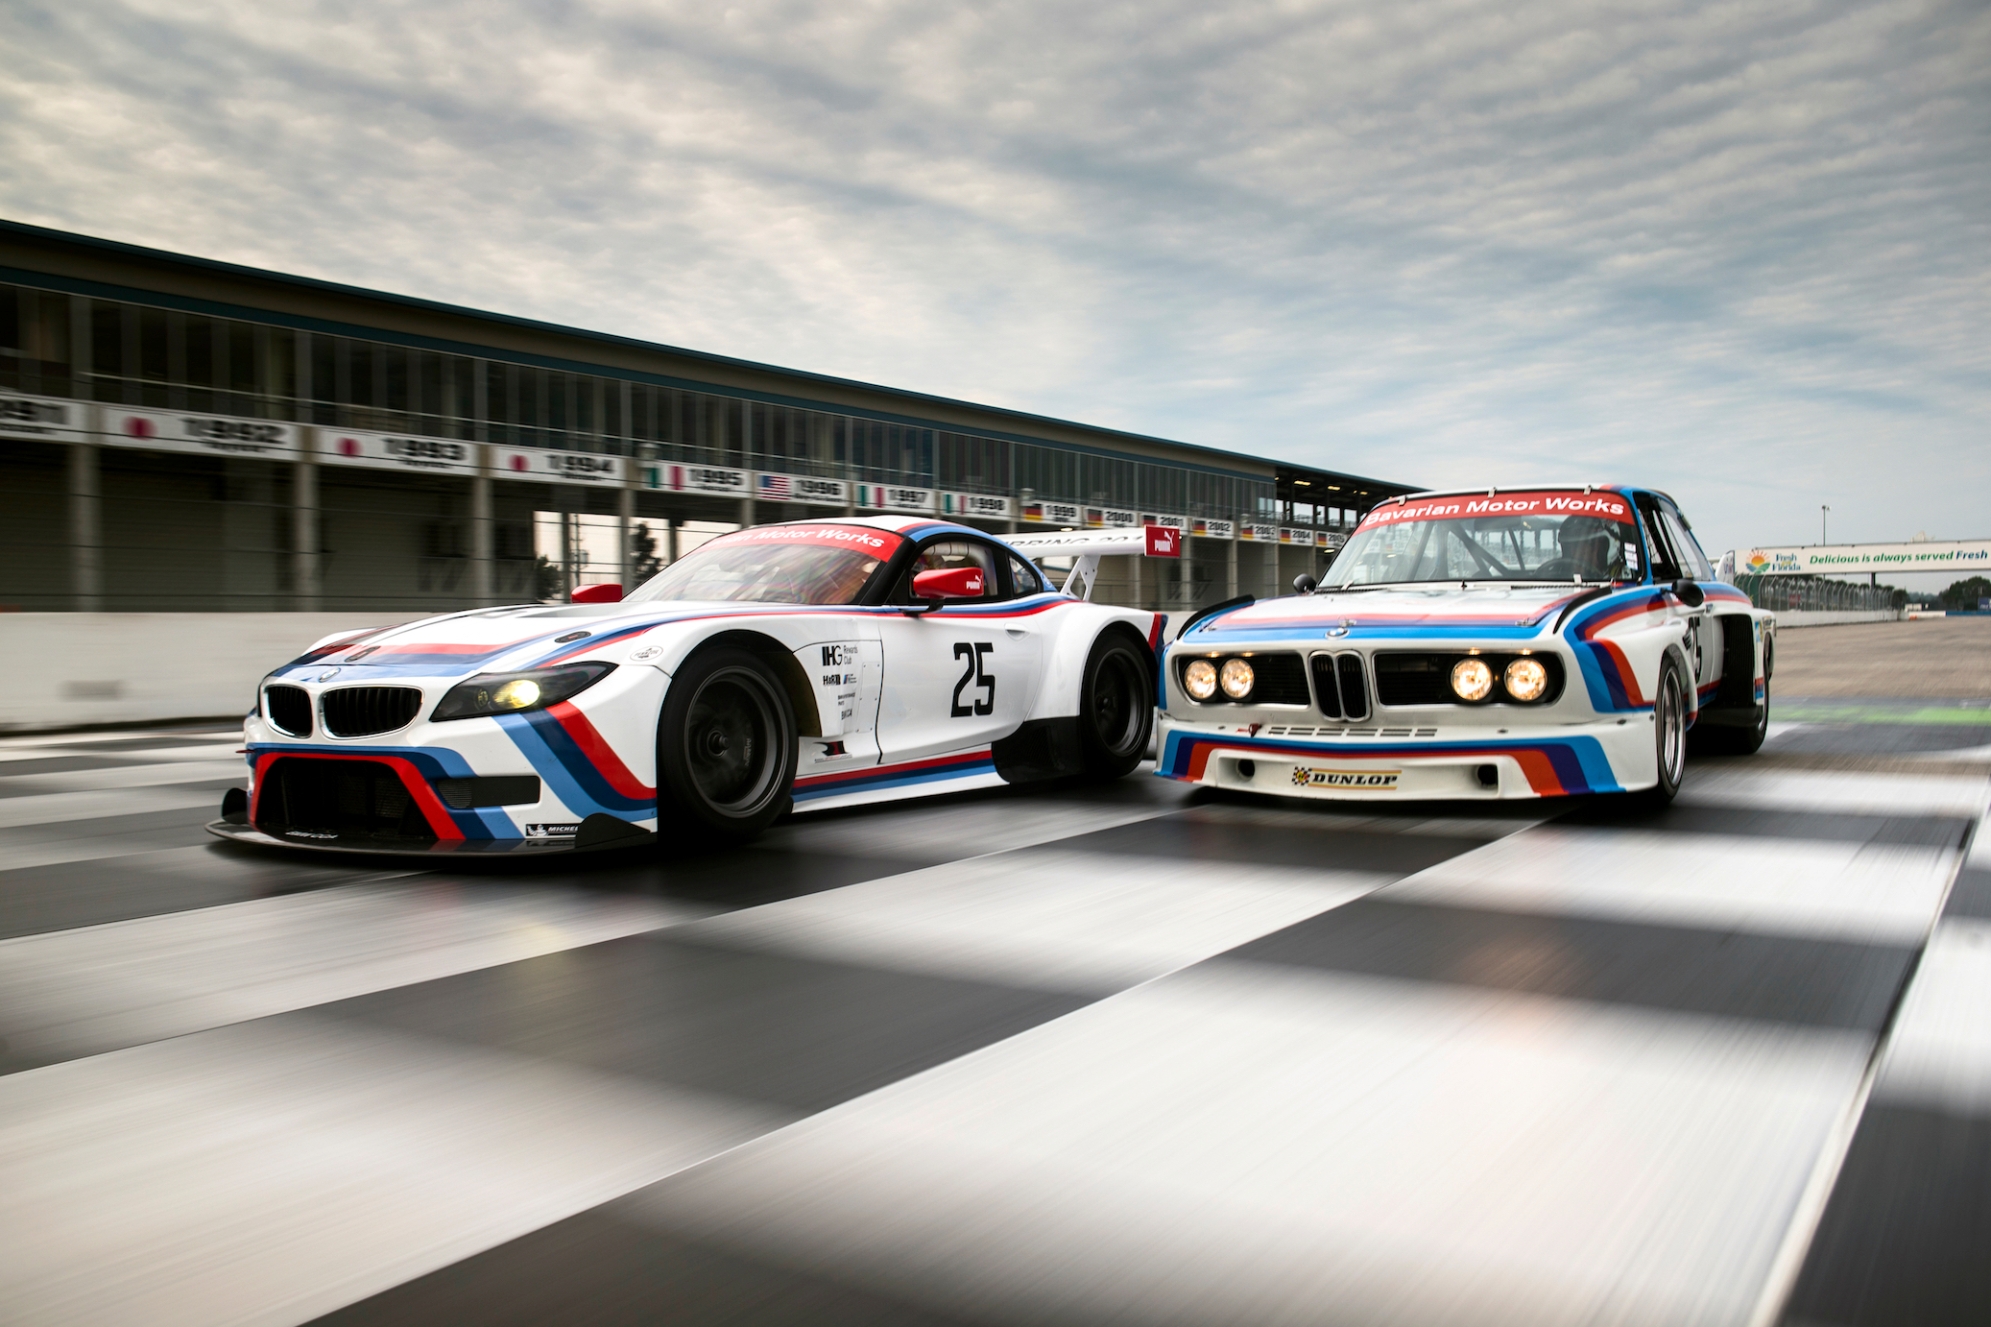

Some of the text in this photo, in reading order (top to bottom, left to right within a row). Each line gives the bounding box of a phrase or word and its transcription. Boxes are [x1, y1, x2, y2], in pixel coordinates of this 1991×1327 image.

[179, 418, 287, 444] 1992
[381, 438, 467, 461] 1993
[545, 455, 615, 473] 1994
[689, 469, 744, 485] 1995
[793, 480, 841, 495] 1996
[888, 489, 928, 502] 1997
[969, 497, 1005, 510] 1998
[1046, 505, 1076, 518] 1999
[1105, 511, 1133, 523] 2000
[1364, 497, 1625, 527] Bavarian Motor Works
[1208, 521, 1231, 532] 2002
[755, 530, 814, 540] Motor
[816, 529, 884, 547] Works
[1809, 550, 1988, 566] Delicious is always served Fresh
[822, 645, 843, 666] IHG
[951, 642, 996, 718] 25
[1312, 773, 1398, 785] DUNLOP
